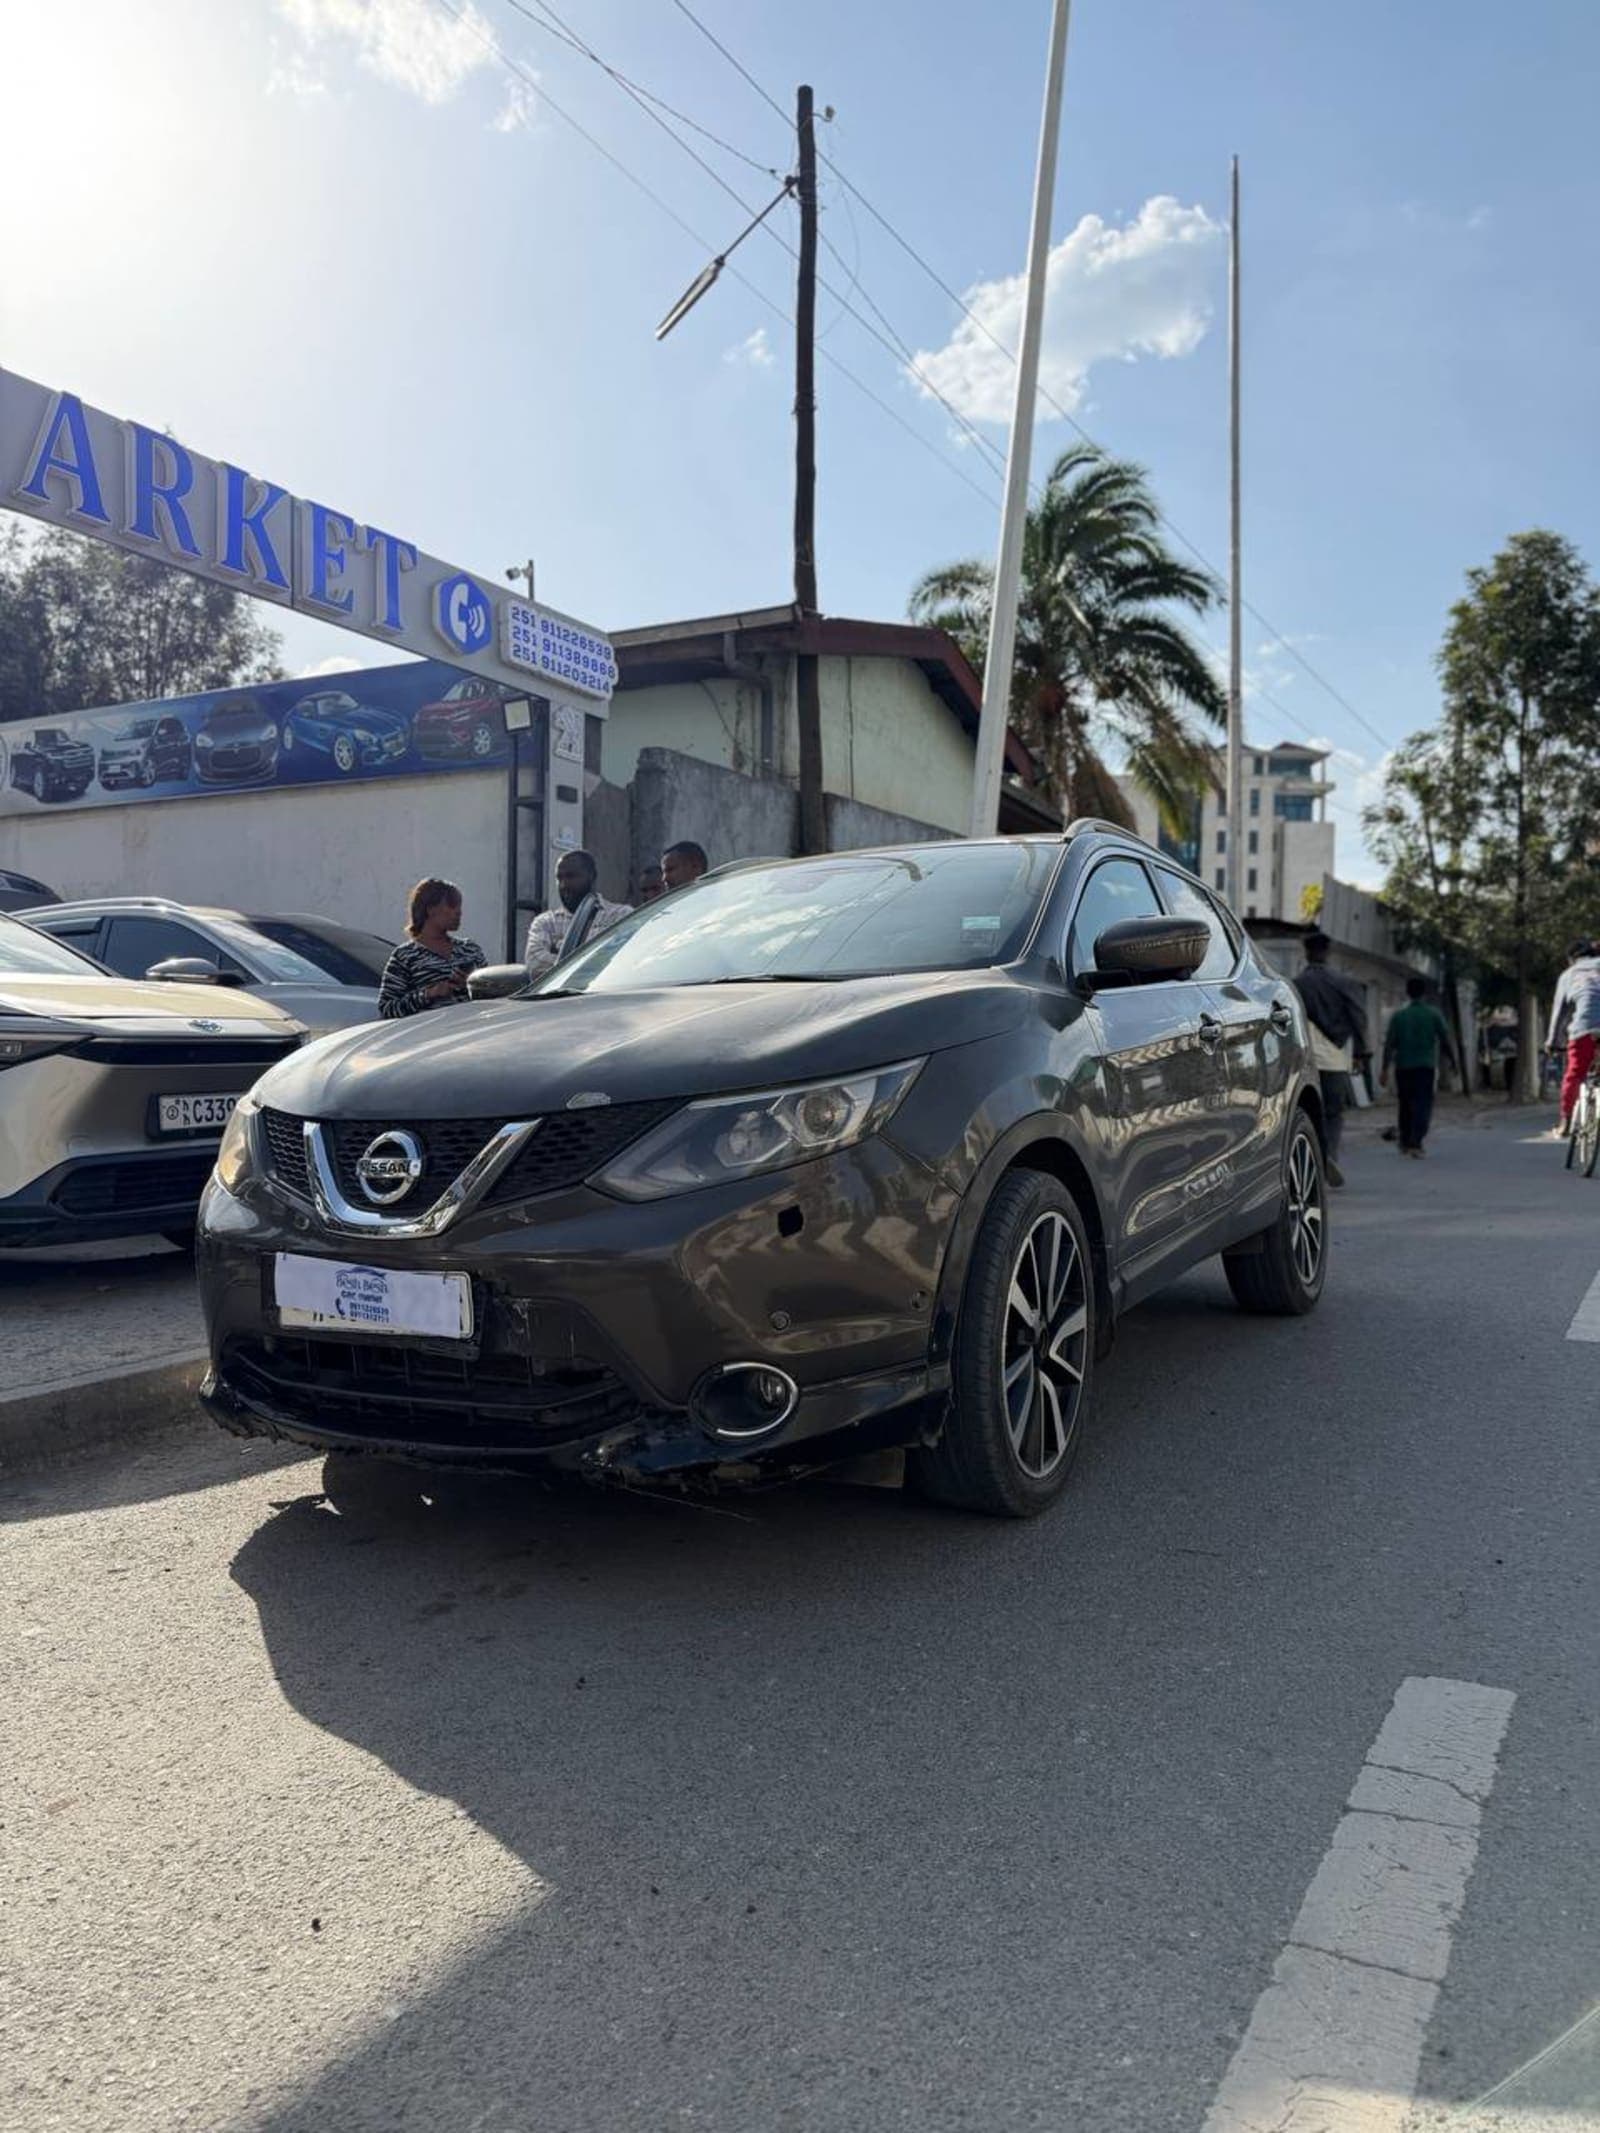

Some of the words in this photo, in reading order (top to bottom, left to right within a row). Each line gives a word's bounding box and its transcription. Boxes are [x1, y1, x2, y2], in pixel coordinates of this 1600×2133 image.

[511, 606, 535, 628] 251
[512, 625, 537, 647] 251
[512, 644, 537, 665] 251
[360, 1160, 407, 1175] NISSAN
